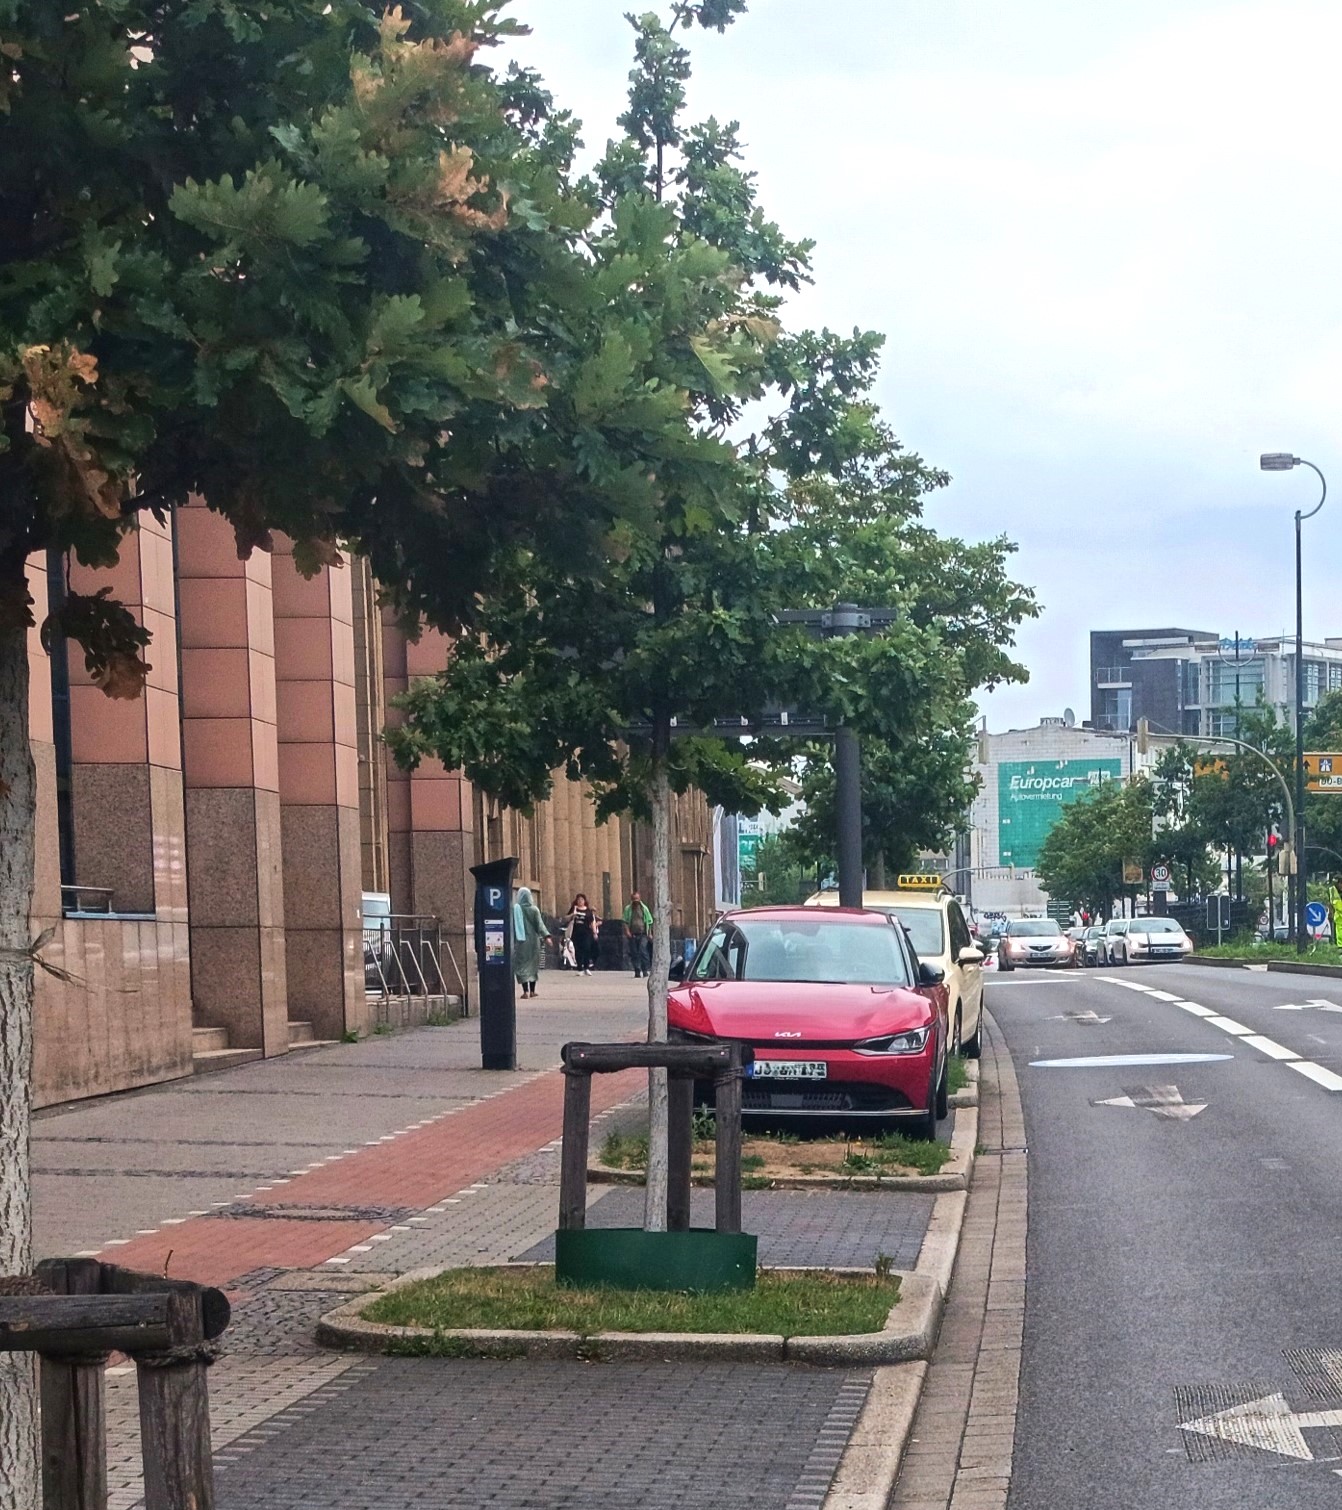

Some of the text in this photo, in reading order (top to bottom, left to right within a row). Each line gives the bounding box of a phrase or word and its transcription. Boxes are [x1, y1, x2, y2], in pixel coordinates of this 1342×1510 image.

[1009, 775, 1075, 792] Europcar
[1155, 868, 1167, 878] 30
[903, 876, 933, 885] TAXI
[489, 888, 502, 907] P
